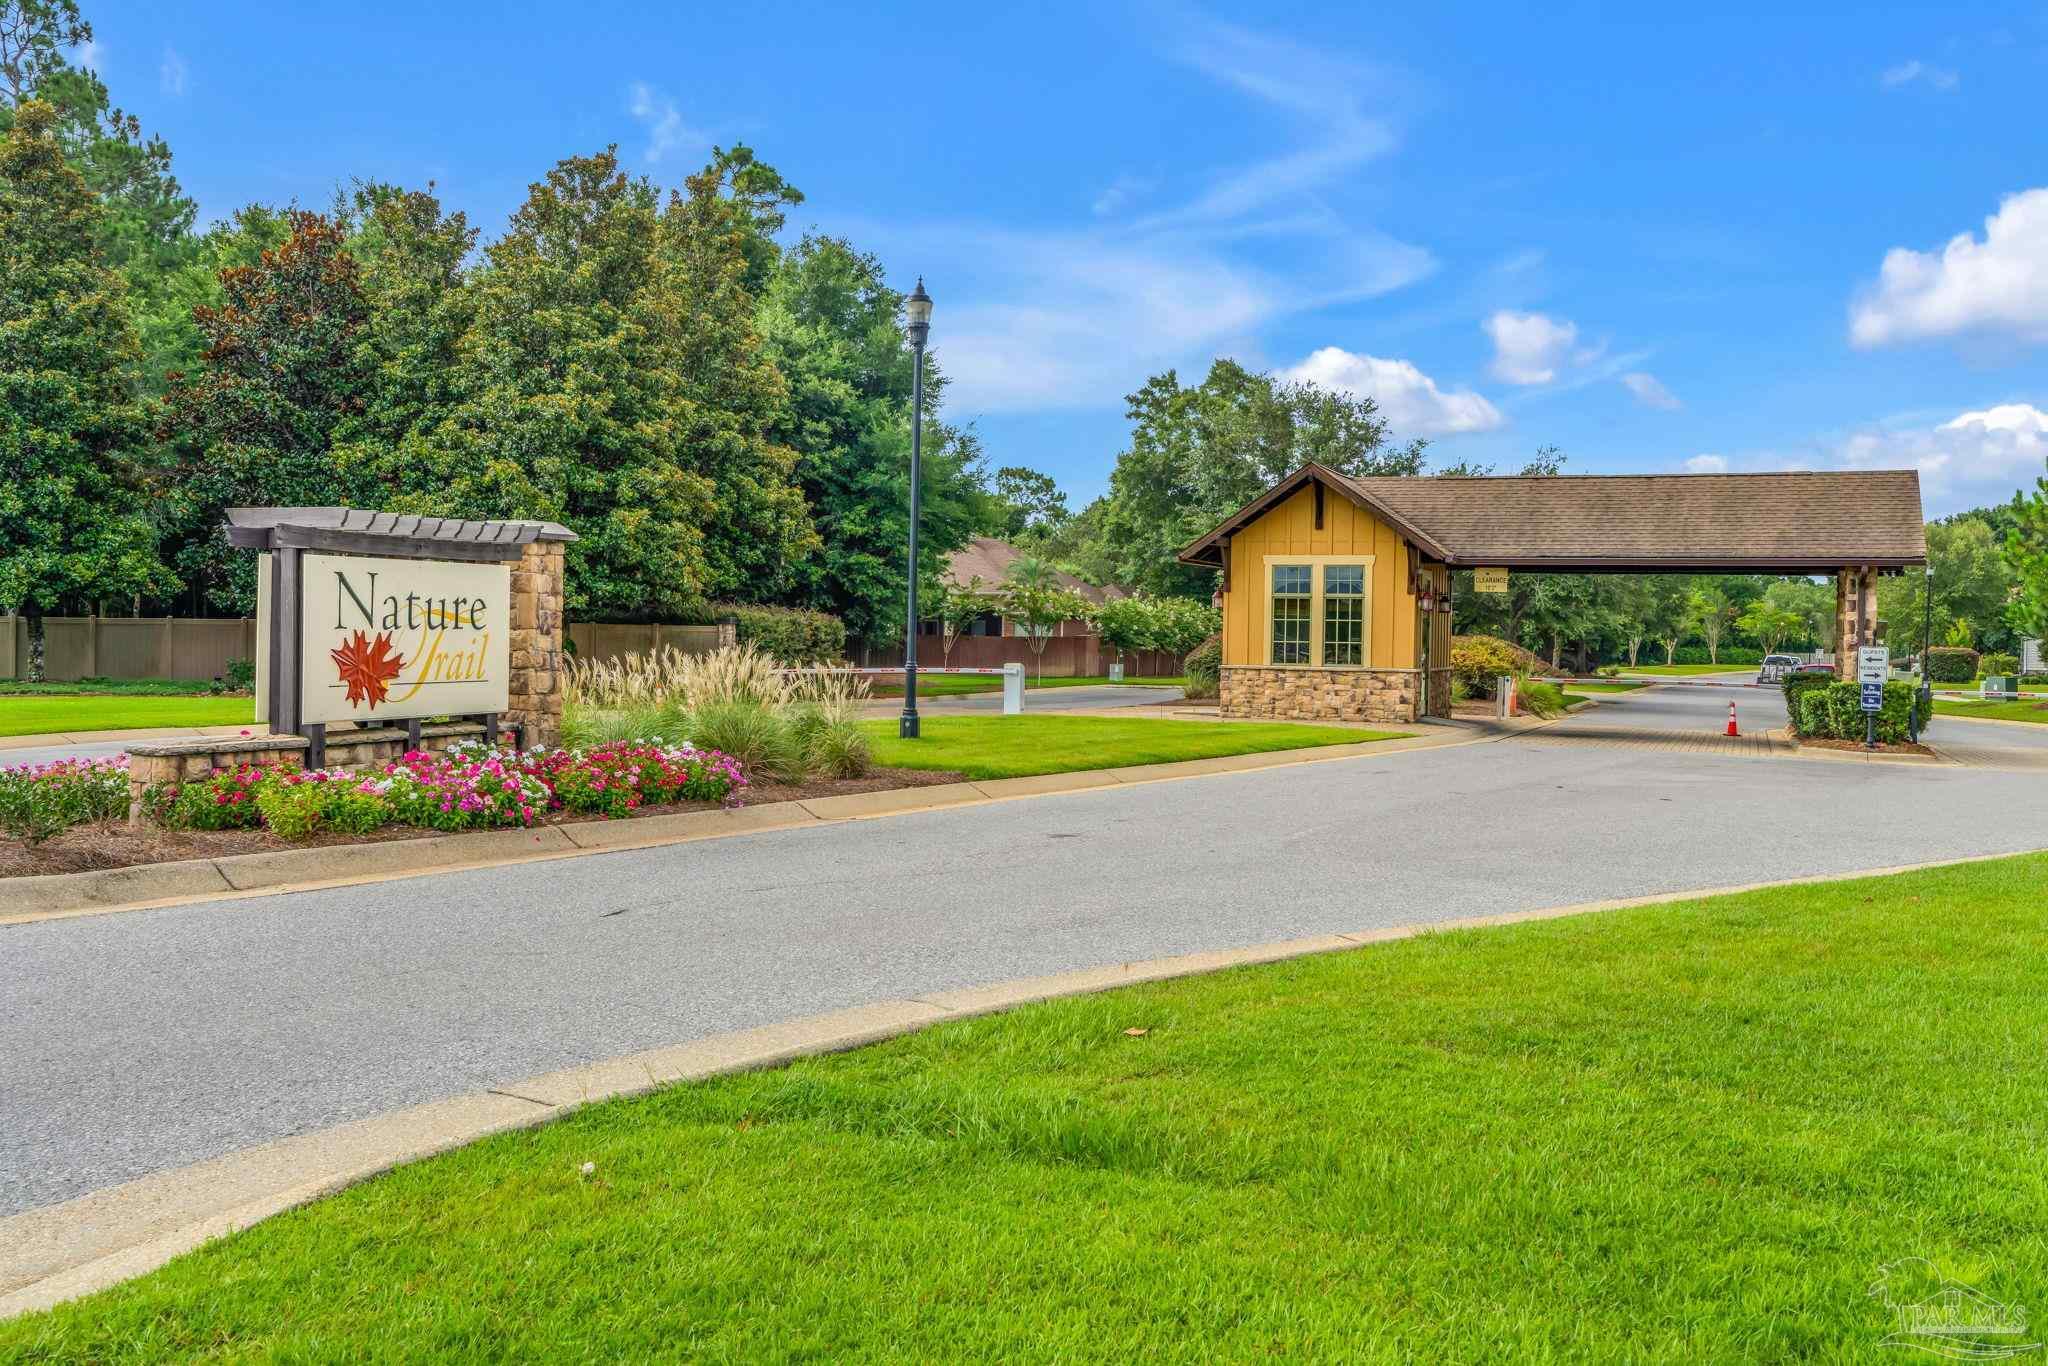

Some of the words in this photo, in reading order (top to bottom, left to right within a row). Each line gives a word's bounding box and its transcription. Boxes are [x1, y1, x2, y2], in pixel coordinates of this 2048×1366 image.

[334, 571, 488, 630] Nature
[1476, 576, 1508, 584] CLEARANCE
[389, 616, 490, 703] Trail
